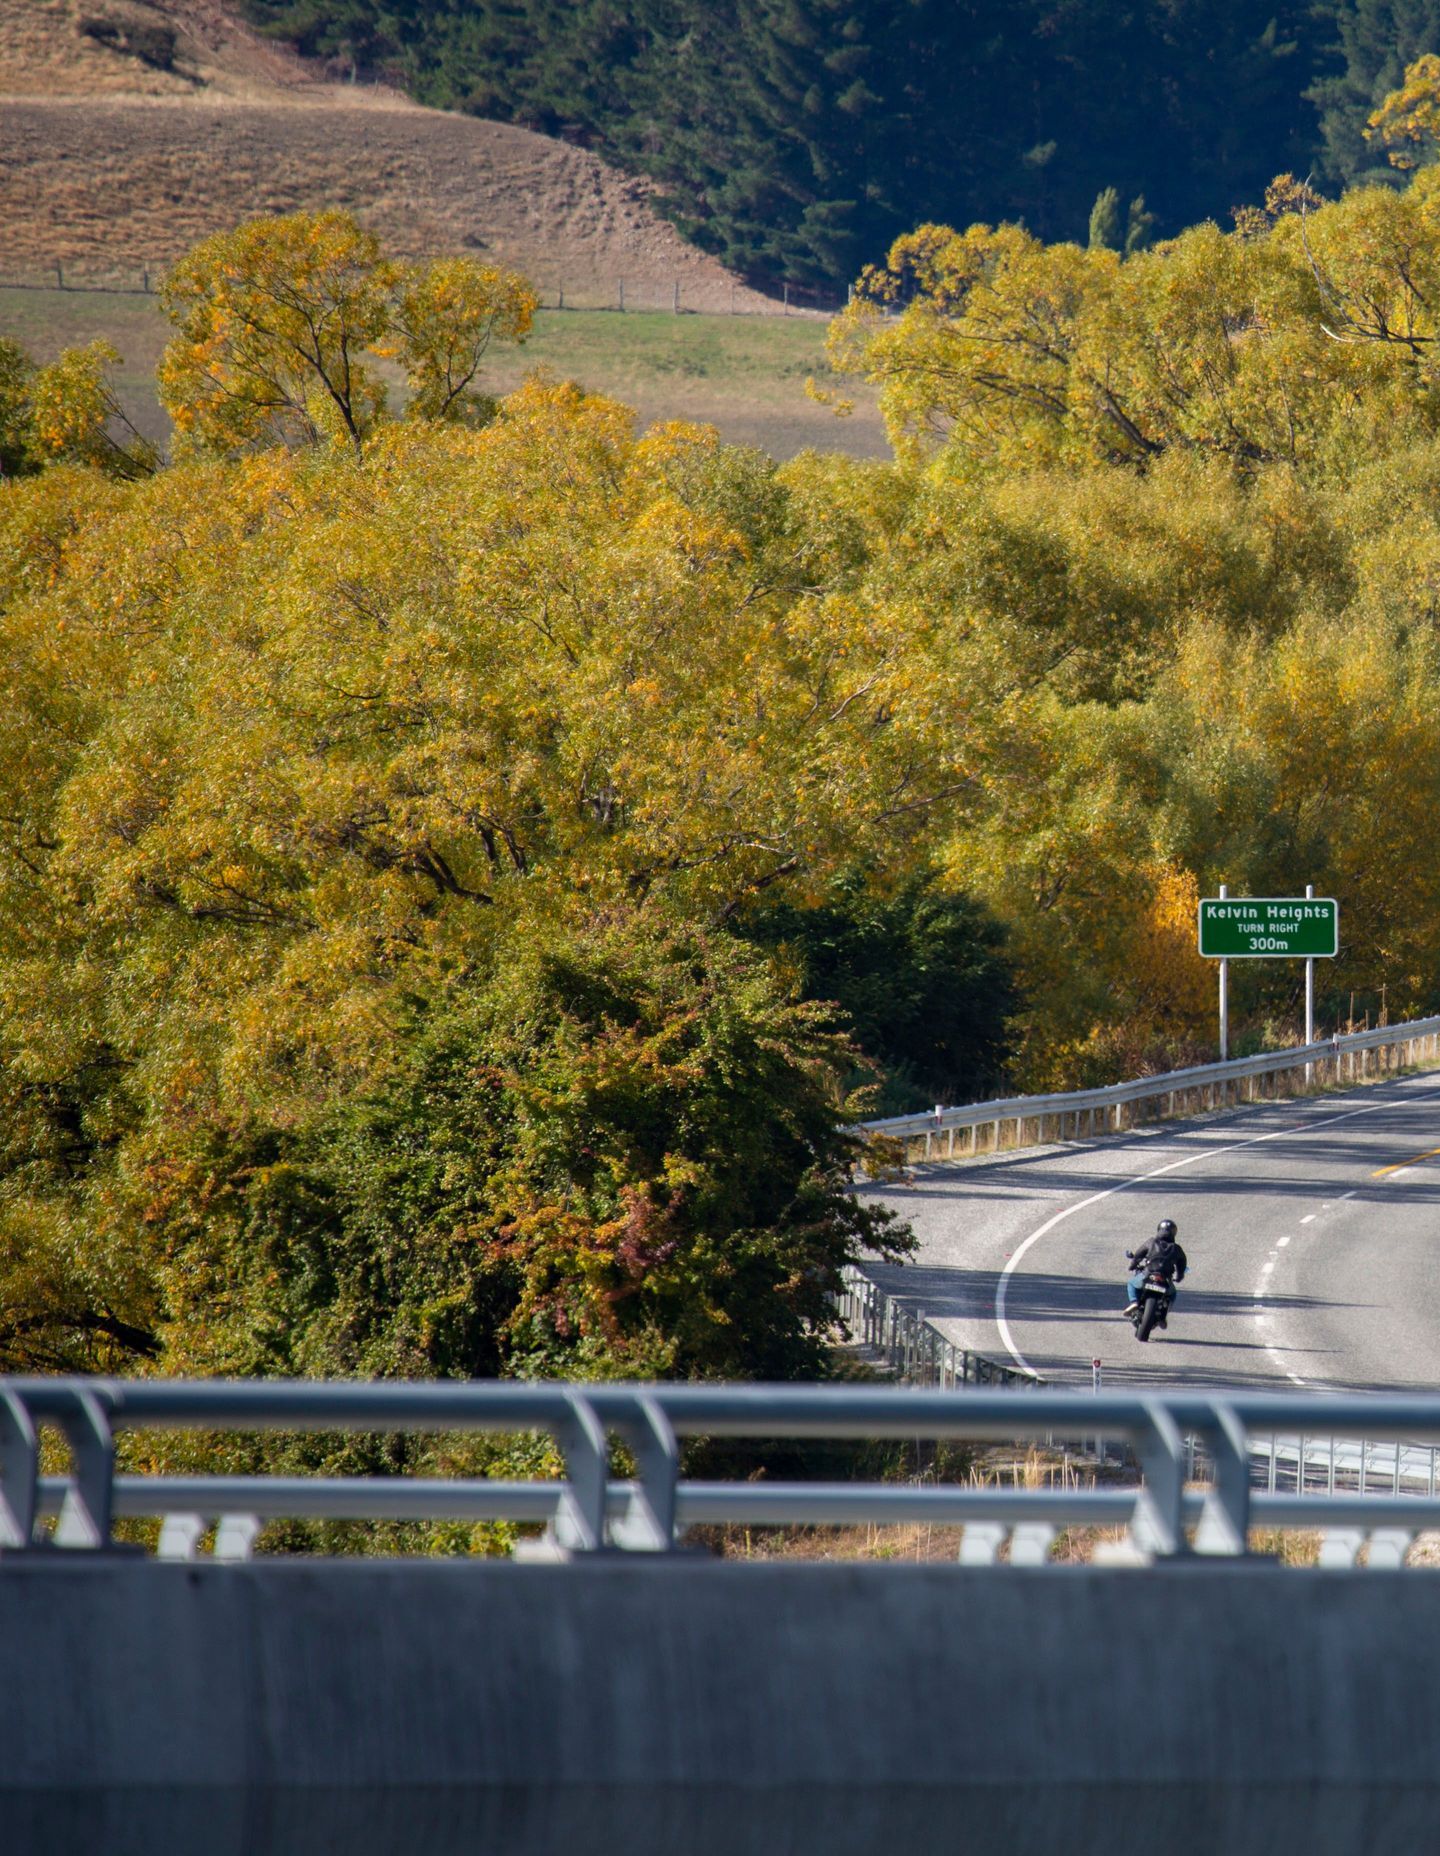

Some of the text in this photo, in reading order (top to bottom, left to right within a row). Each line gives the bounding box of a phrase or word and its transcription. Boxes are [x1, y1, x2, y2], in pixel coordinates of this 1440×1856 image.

[1207, 906, 1329, 921] Kelvin Heights
[1237, 923, 1299, 933] TURN RIGHT
[1249, 938, 1288, 950] 300m
